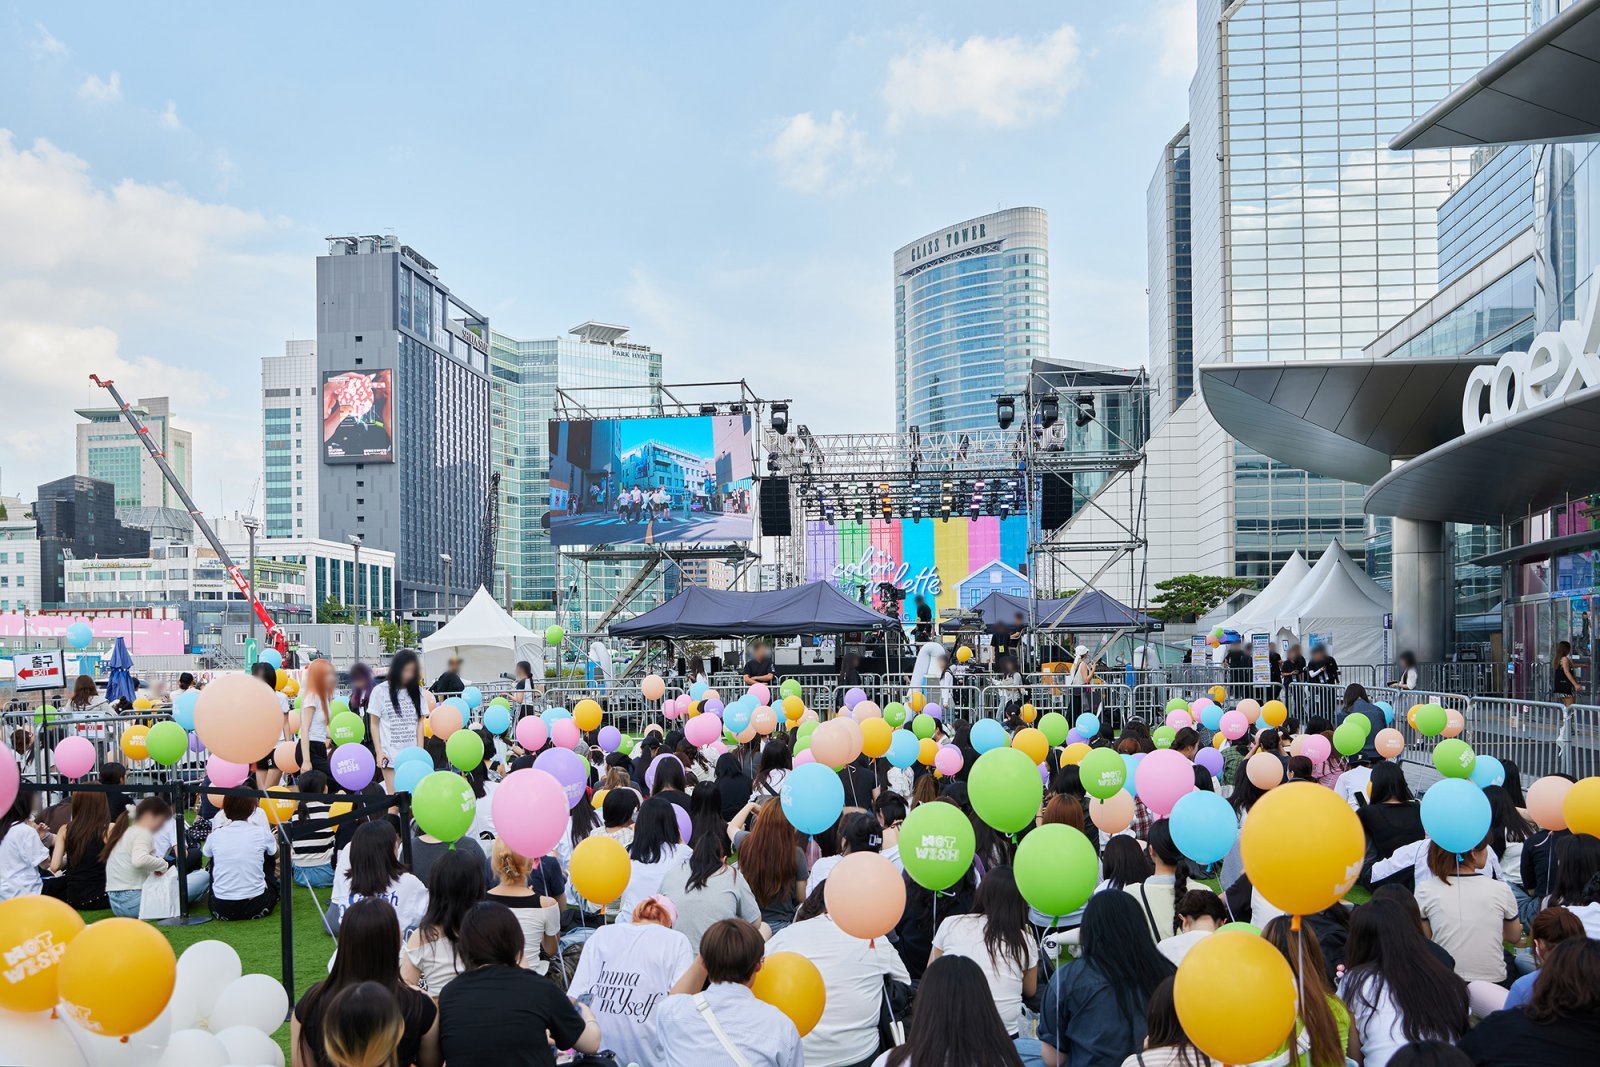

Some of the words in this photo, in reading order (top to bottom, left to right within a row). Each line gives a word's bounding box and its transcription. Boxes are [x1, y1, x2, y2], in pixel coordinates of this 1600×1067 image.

[911, 238, 940, 262] GLASS
[946, 223, 986, 248] TOWER
[612, 350, 630, 358] PARK
[632, 353, 654, 361] HYATT
[832, 546, 896, 577] color
[31, 655, 54, 669] 출구
[32, 669, 50, 677] EXIT
[915, 846, 960, 862] WISH
[597, 960, 640, 987] Imma
[599, 988, 664, 1024] myself
